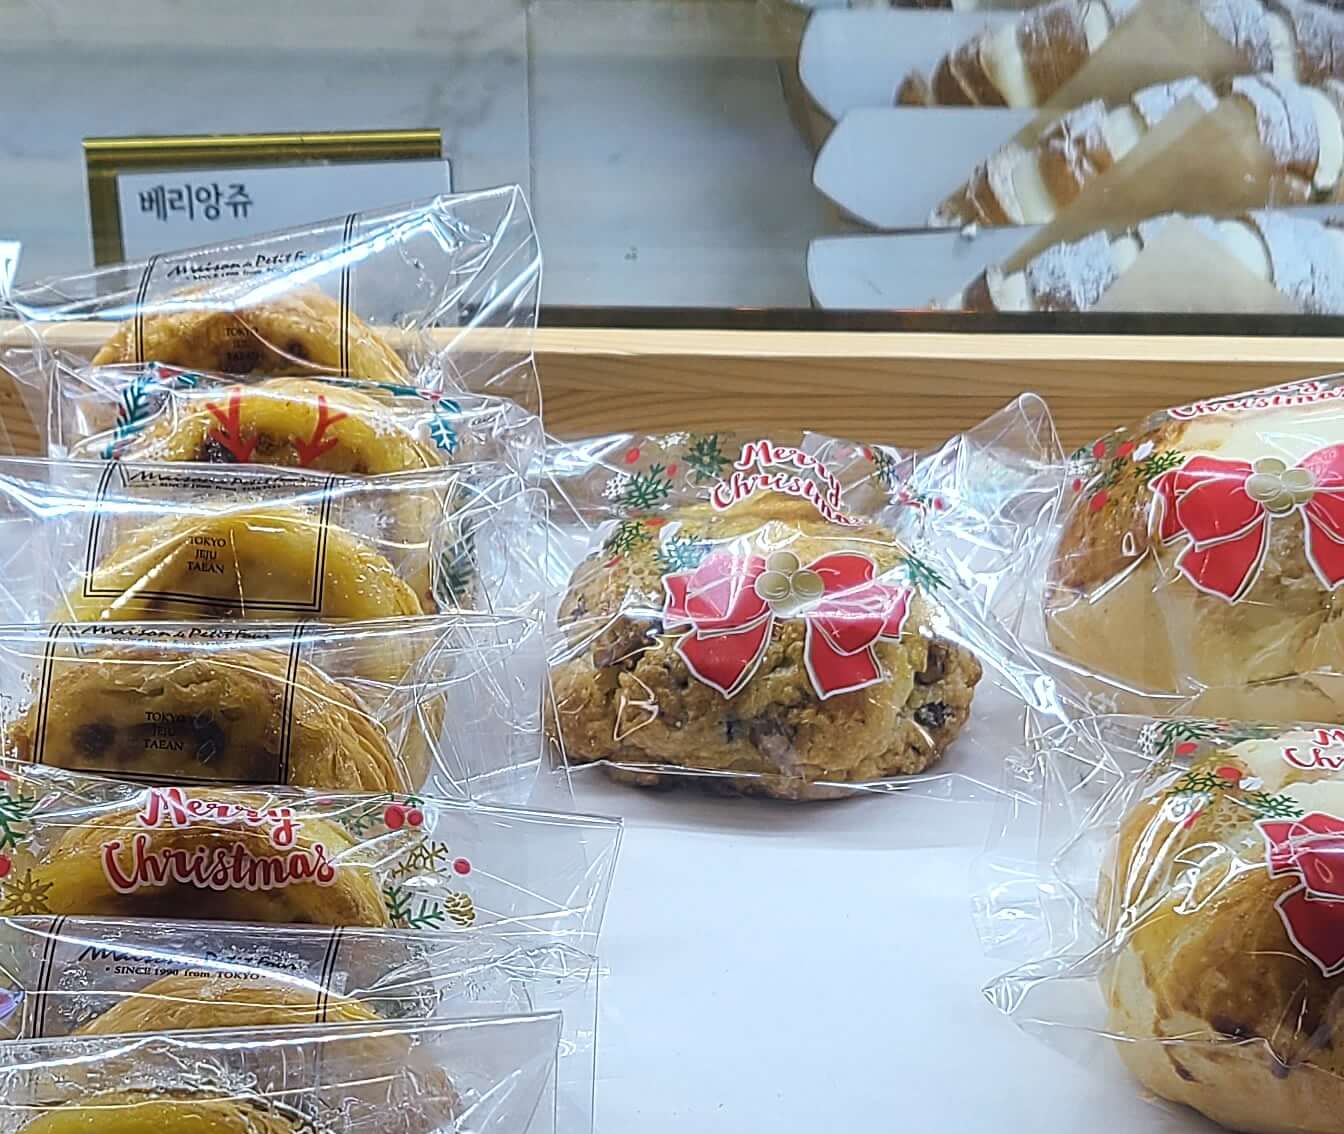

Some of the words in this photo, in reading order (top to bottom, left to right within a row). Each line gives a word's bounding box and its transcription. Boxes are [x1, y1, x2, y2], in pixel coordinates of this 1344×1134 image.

[138, 182, 254, 222] 베리앙쥬
[143, 738, 185, 752] TAEAN
[136, 786, 303, 848] Merry
[100, 832, 338, 894] Christmas
